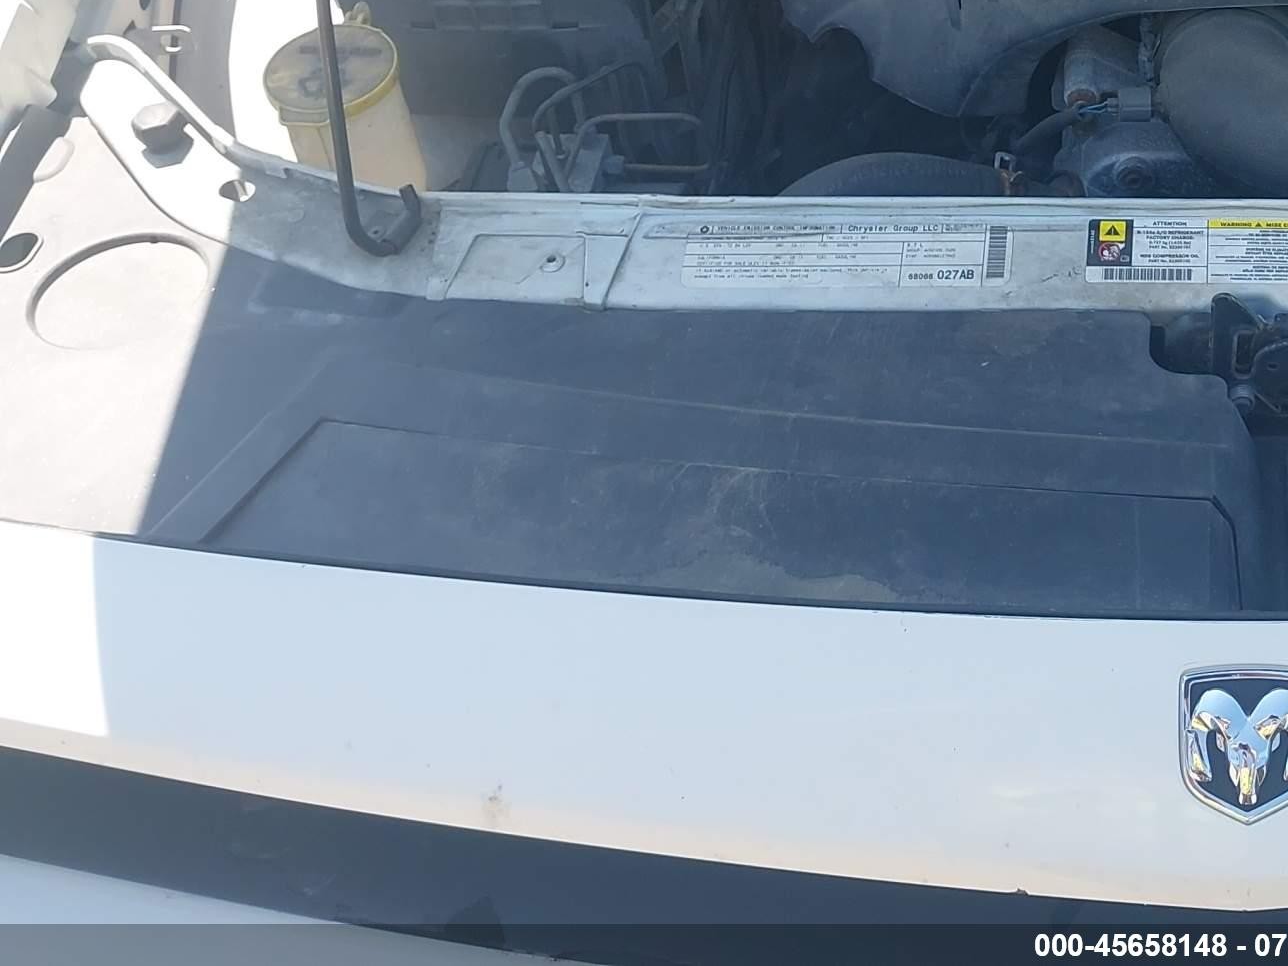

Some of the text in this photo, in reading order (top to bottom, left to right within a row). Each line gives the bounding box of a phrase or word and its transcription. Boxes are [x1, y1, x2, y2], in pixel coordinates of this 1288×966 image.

[847, 224, 888, 233] Chrysler
[893, 224, 919, 234] Group
[922, 224, 939, 232] LLC
[936, 268, 975, 281] 027AB
